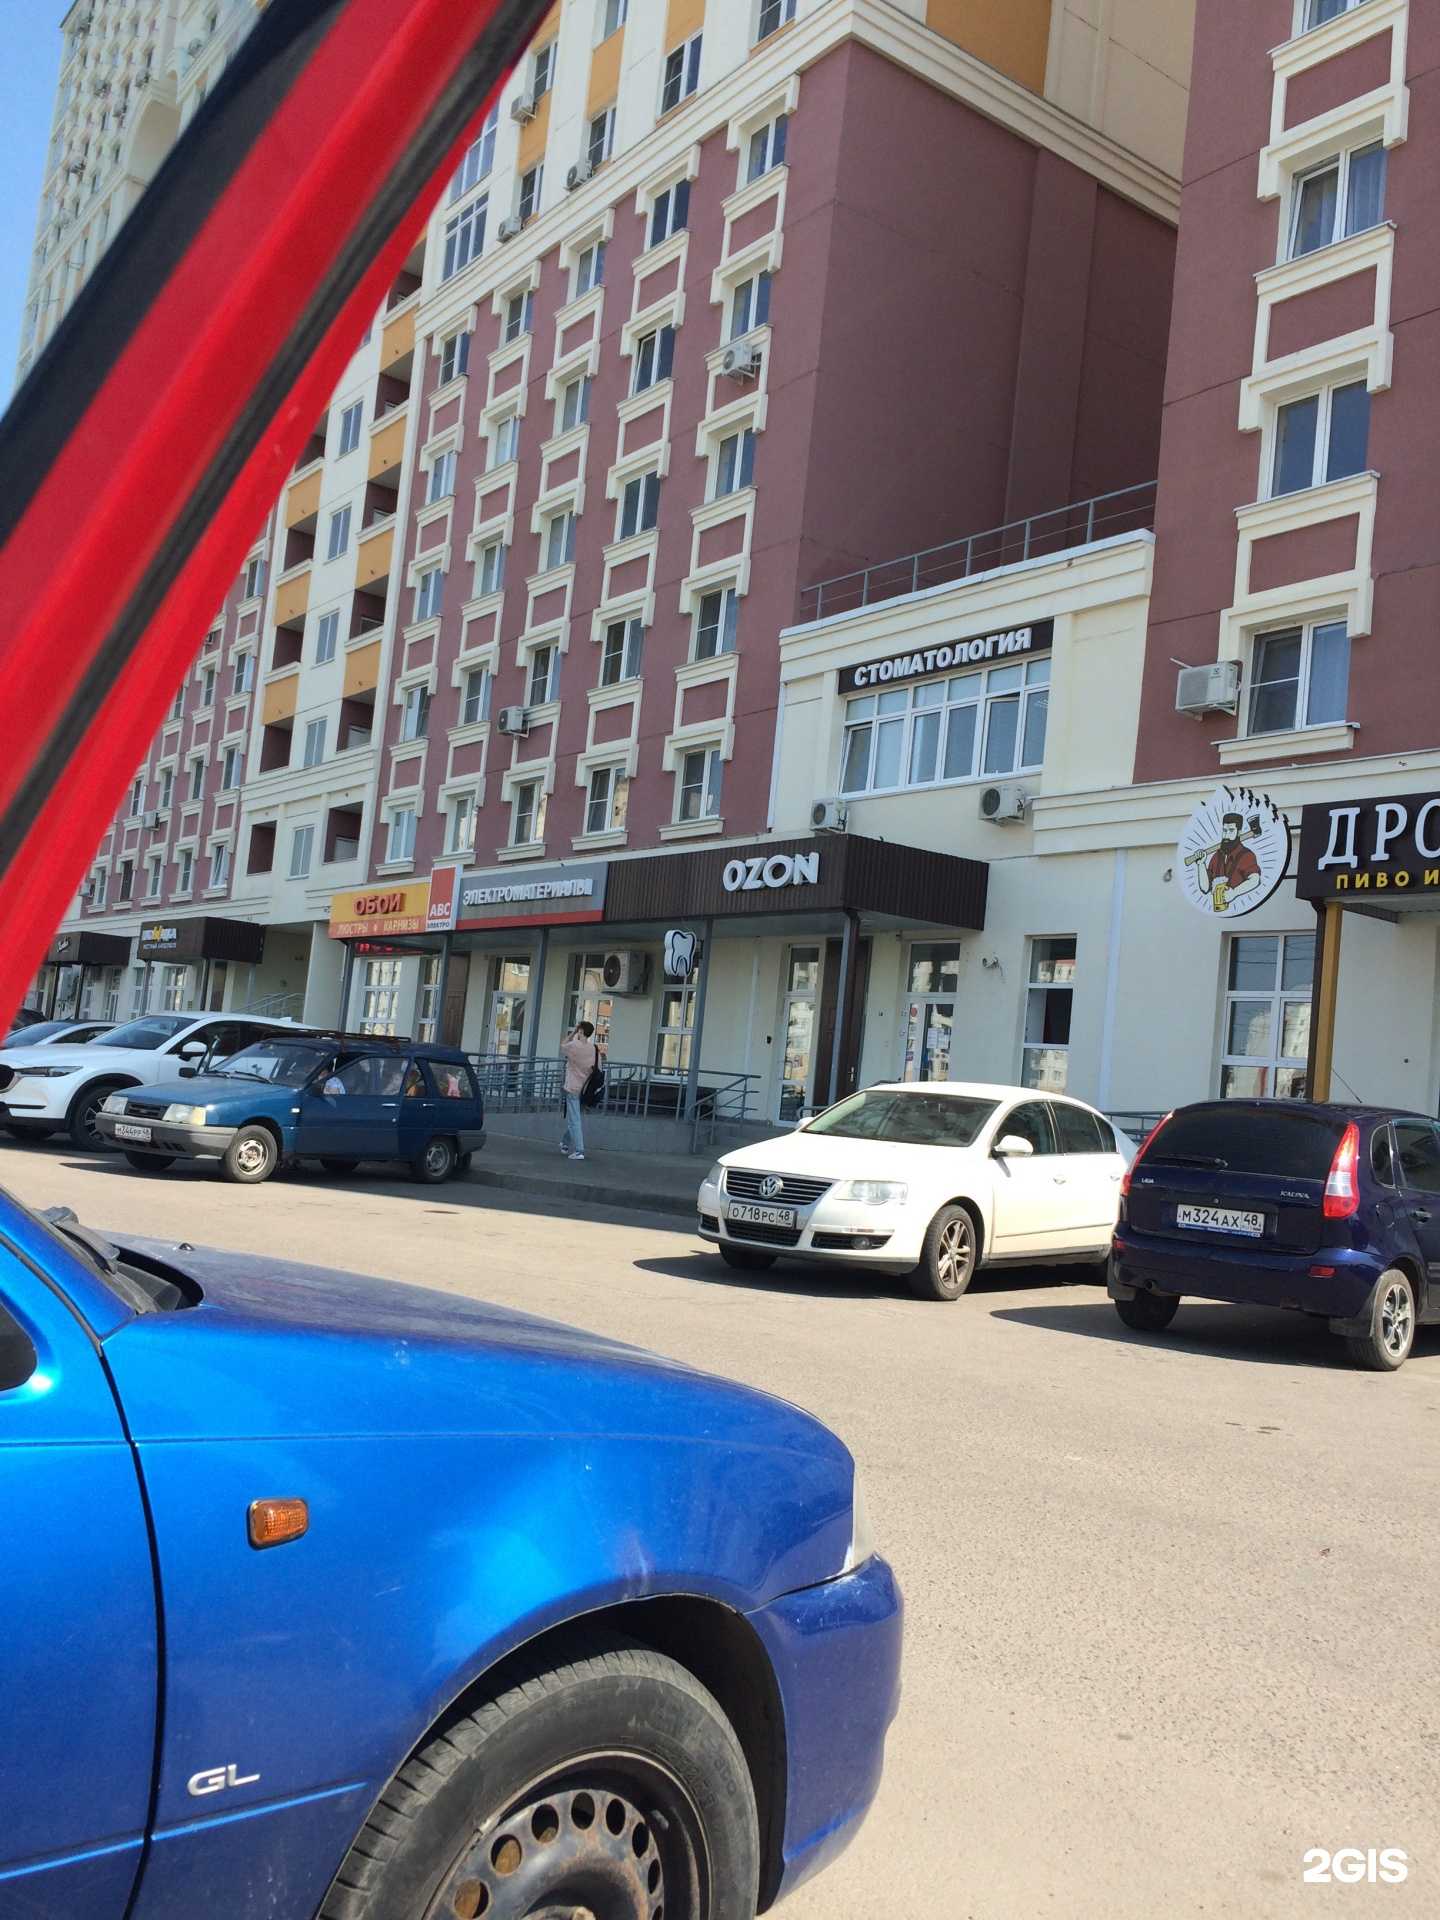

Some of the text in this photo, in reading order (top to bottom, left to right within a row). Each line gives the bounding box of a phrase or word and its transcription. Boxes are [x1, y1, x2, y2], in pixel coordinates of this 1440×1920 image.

[854, 627, 1033, 687] СТОМАТОЛОГИЯ
[722, 851, 820, 892] OZON
[1336, 870, 1410, 890] ПИВО
[355, 893, 405, 915] ОБОИ
[462, 878, 593, 906] ЭЛЕКТРОМАТЕРИАЛЫ
[186, 1763, 261, 1797] GL
